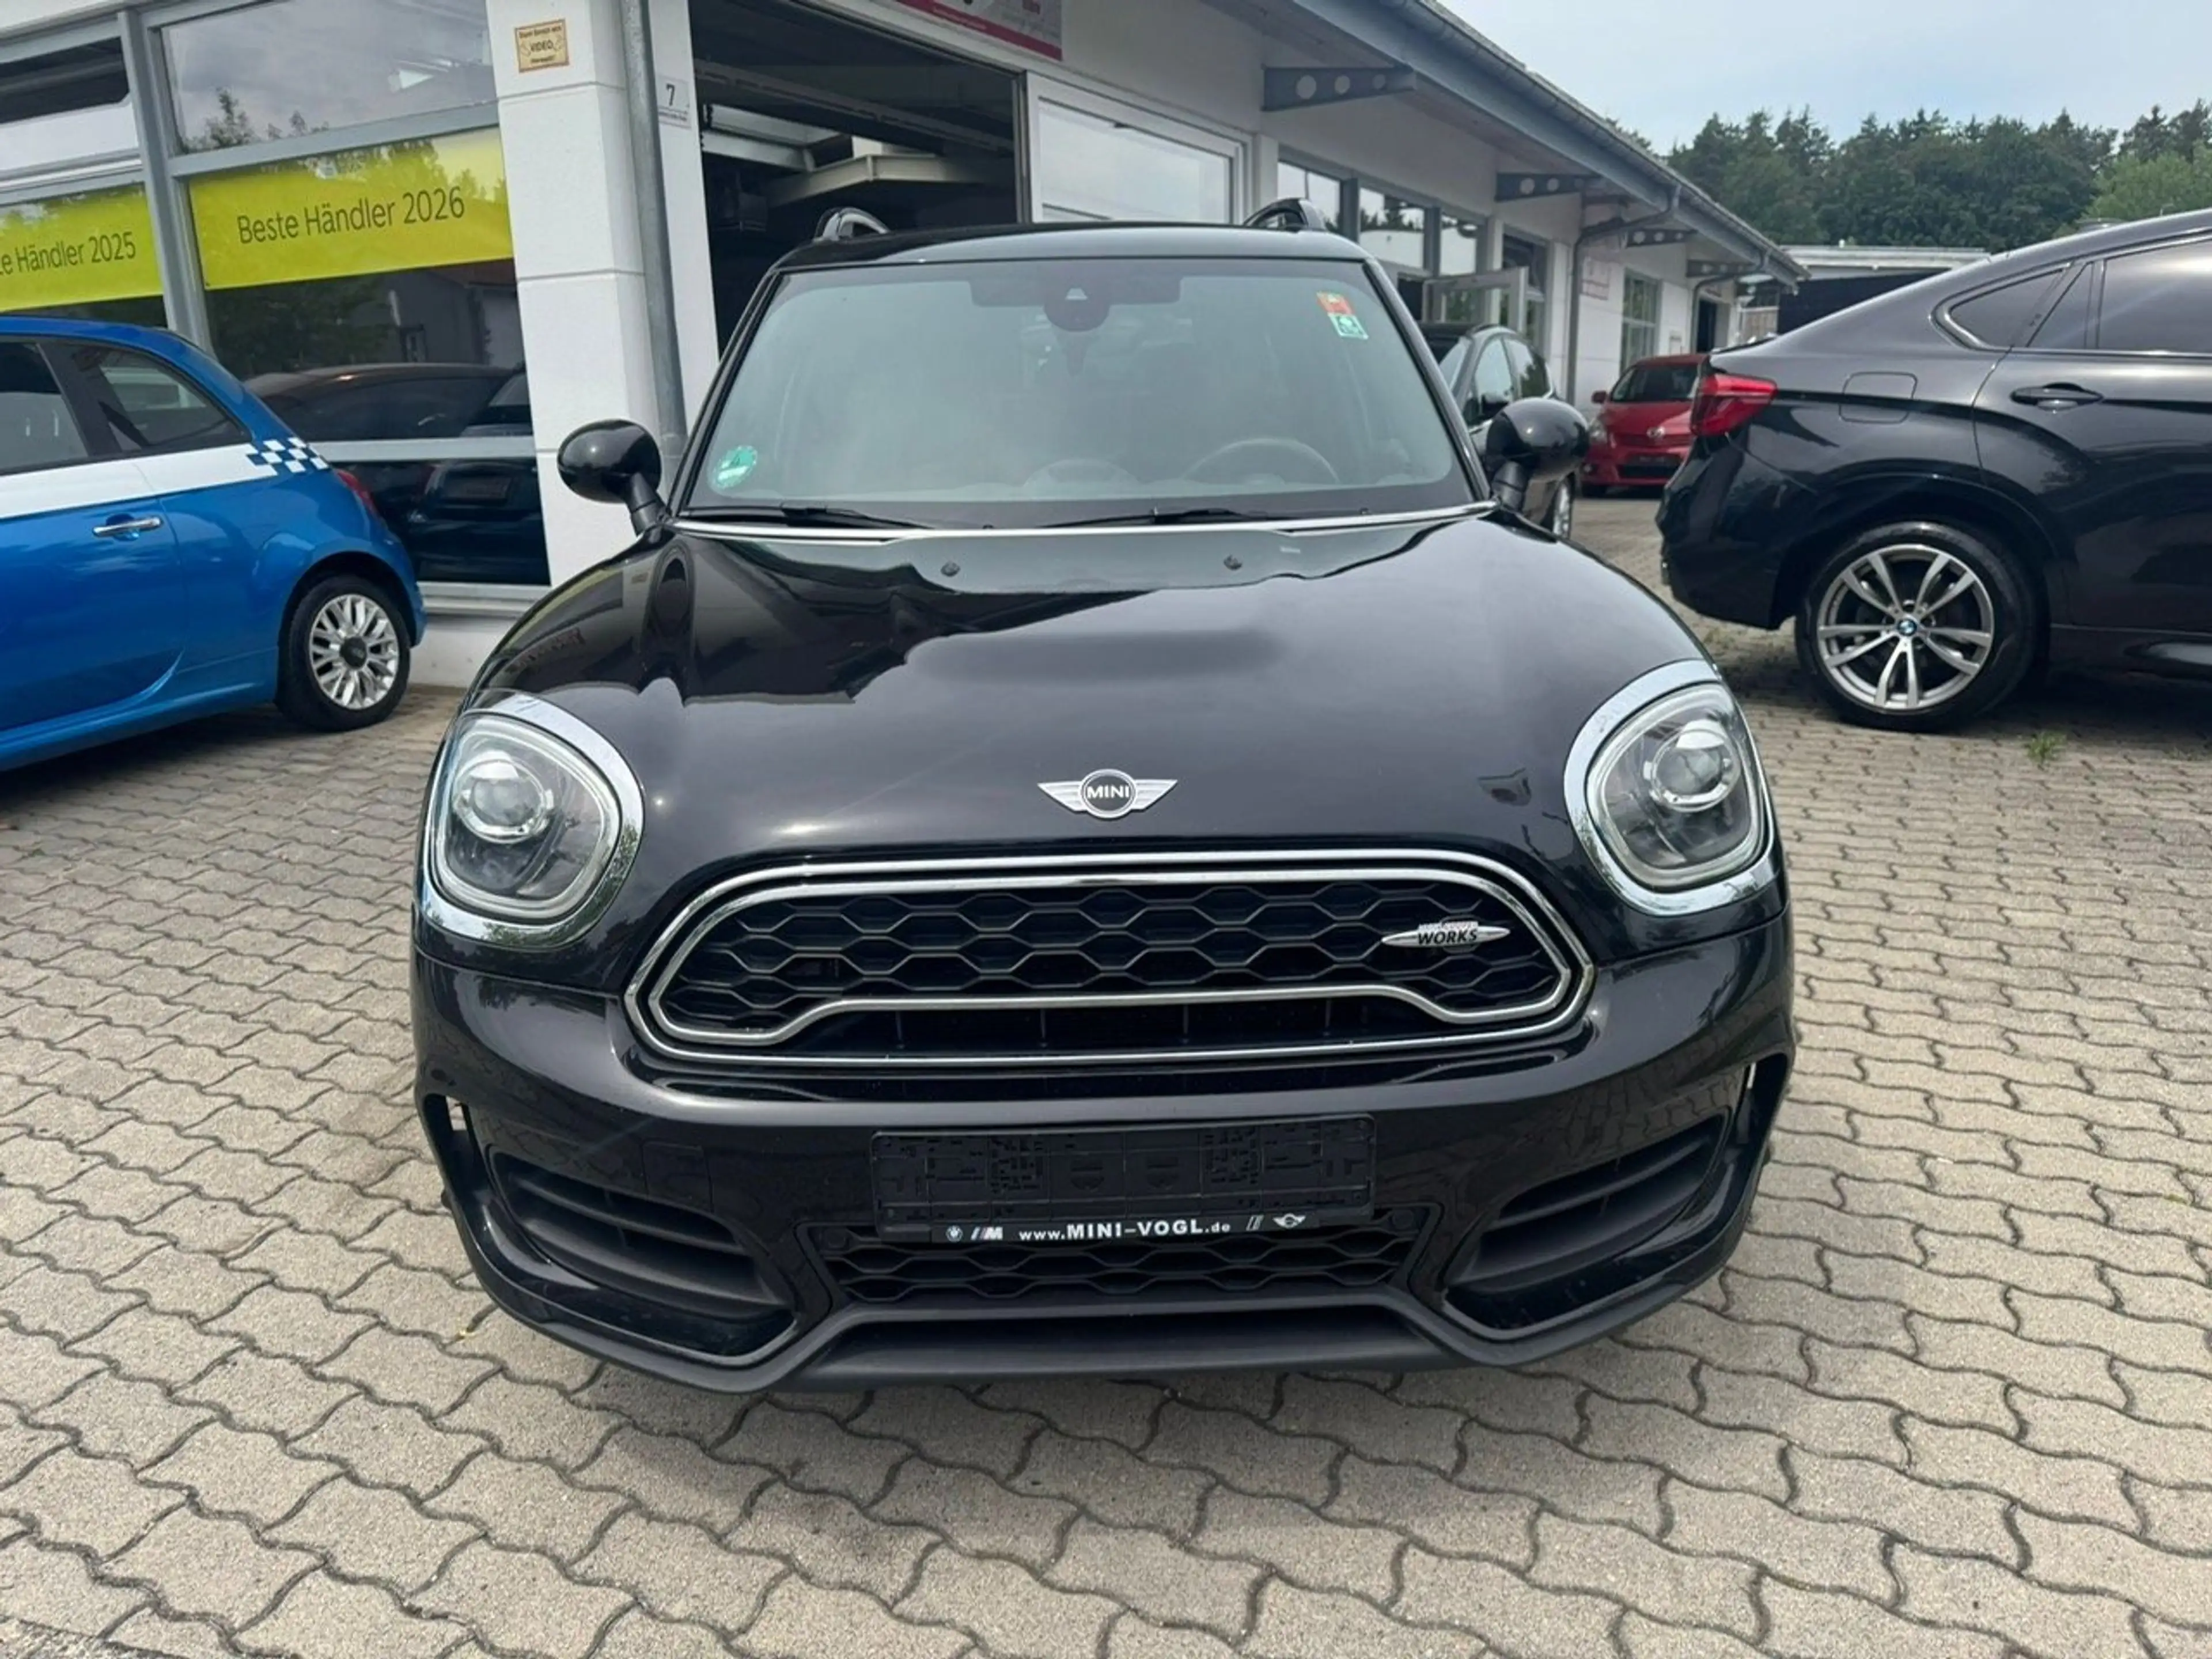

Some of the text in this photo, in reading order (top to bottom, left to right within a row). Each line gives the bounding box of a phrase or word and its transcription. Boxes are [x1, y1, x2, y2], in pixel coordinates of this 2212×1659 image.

[666, 84, 675, 107] 7
[237, 185, 465, 244] Beste Händler 2026
[15, 240, 84, 272] Händler
[88, 232, 137, 264] 2025
[1086, 785, 1130, 799] MINI
[1418, 929, 1478, 945] WORKS
[1019, 1218, 1231, 1241] www.MINI-VOGL.de
